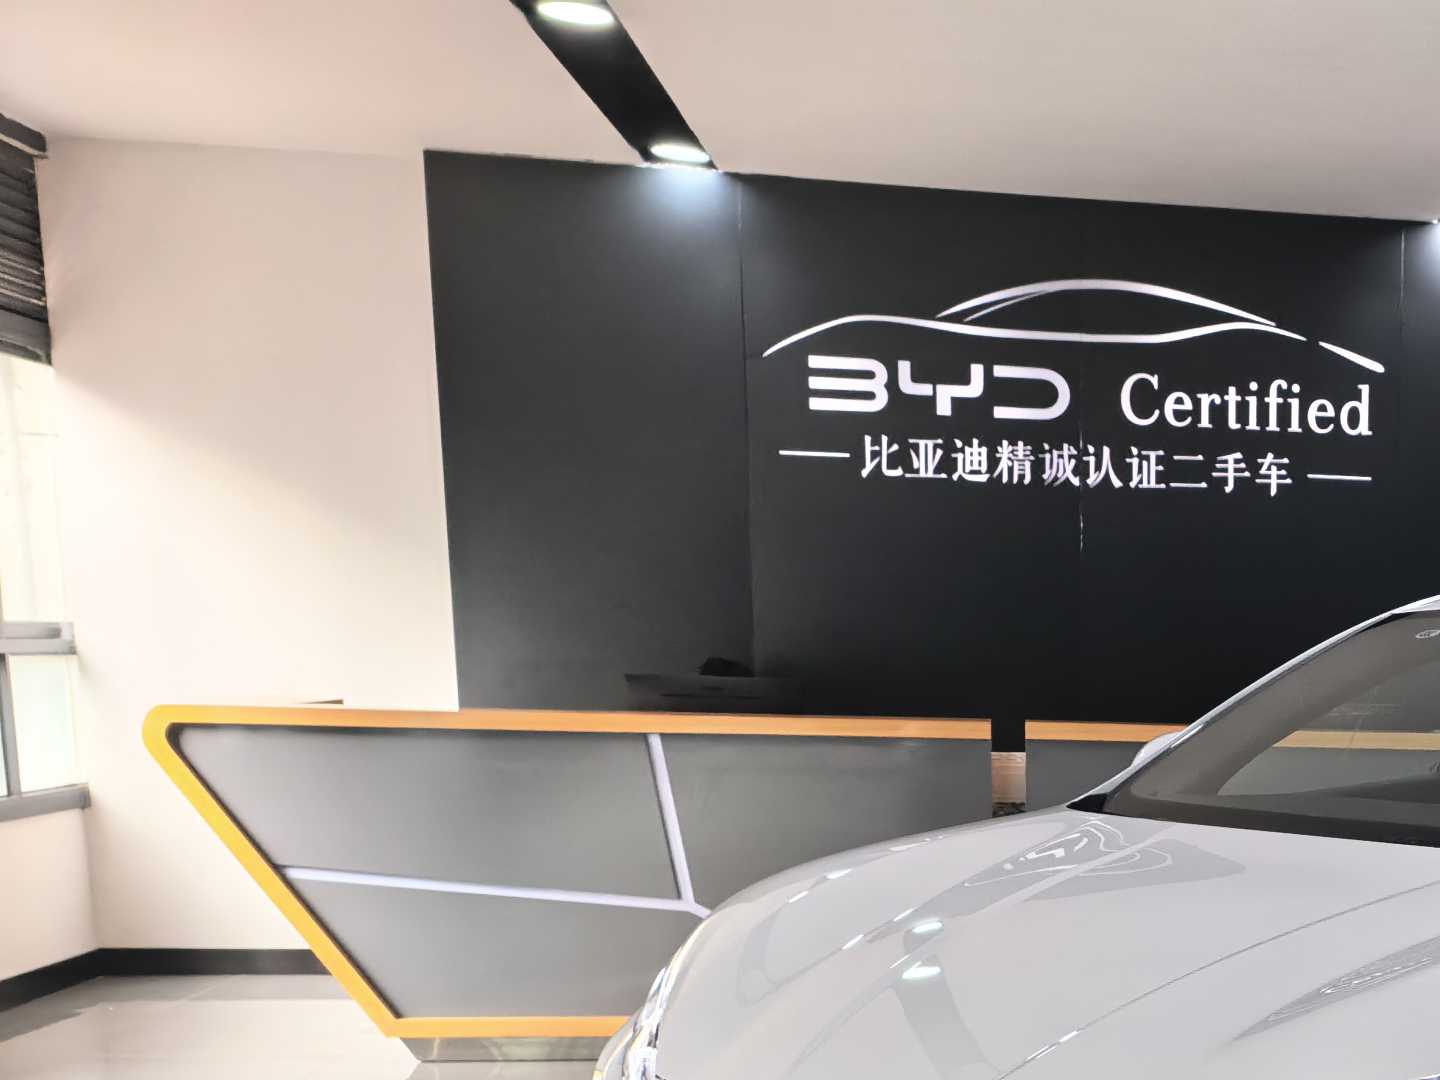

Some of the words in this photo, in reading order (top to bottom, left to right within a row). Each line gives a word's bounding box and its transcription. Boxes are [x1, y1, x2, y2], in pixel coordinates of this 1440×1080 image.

[808, 354, 1071, 421] BYD
[1120, 372, 1373, 436] Certified
[860, 434, 1293, 497] 比亚迪精诚认证二手车
